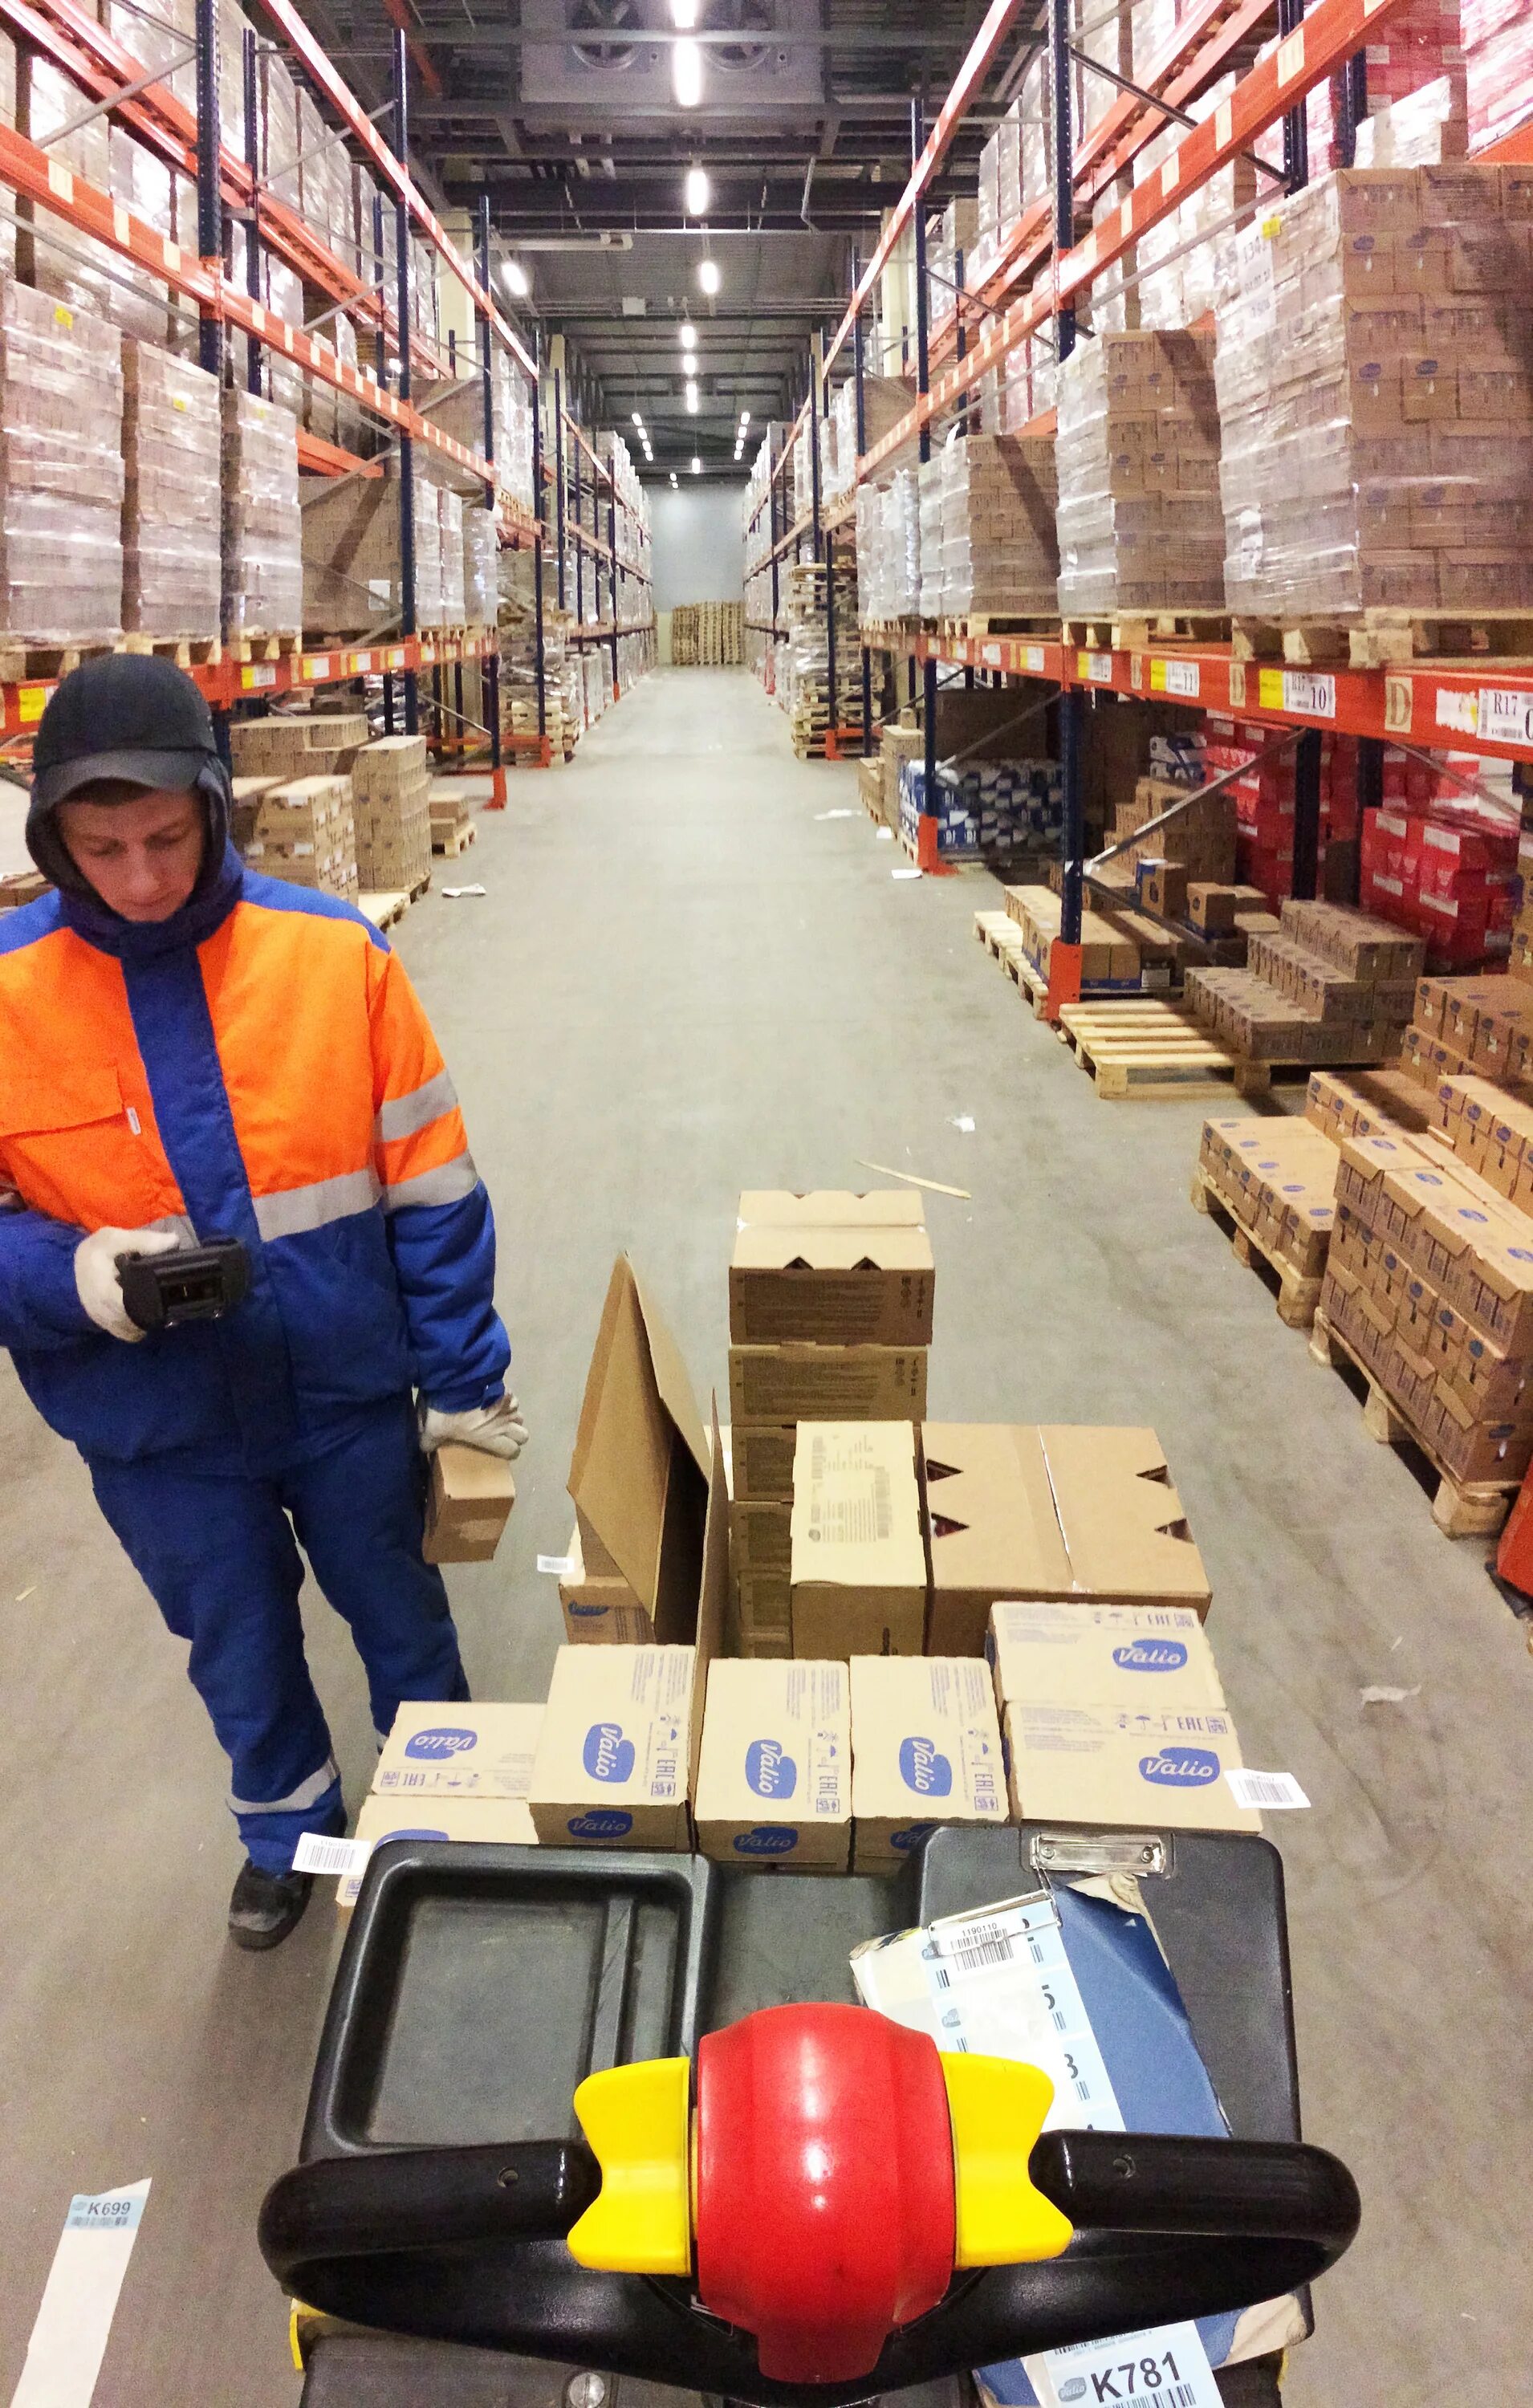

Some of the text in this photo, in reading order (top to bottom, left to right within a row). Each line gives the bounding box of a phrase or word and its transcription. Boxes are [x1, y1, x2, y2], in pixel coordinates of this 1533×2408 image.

[1311, 686, 1327, 710] 10
[1390, 682, 1411, 726] D
[1494, 692, 1518, 716] R17
[1119, 1648, 1181, 1665] Valio
[415, 1735, 473, 1751] Valio
[596, 1727, 620, 1777] Valio
[758, 1743, 781, 1793] Valio
[912, 1740, 935, 1791] Valio
[1145, 1759, 1214, 1777] Valio
[572, 1819, 627, 1832] Valio
[738, 1833, 791, 1847] Valio
[962, 1922, 998, 1938] 1190110
[87, 2202, 131, 2216] K699
[1091, 2351, 1181, 2403] K781
